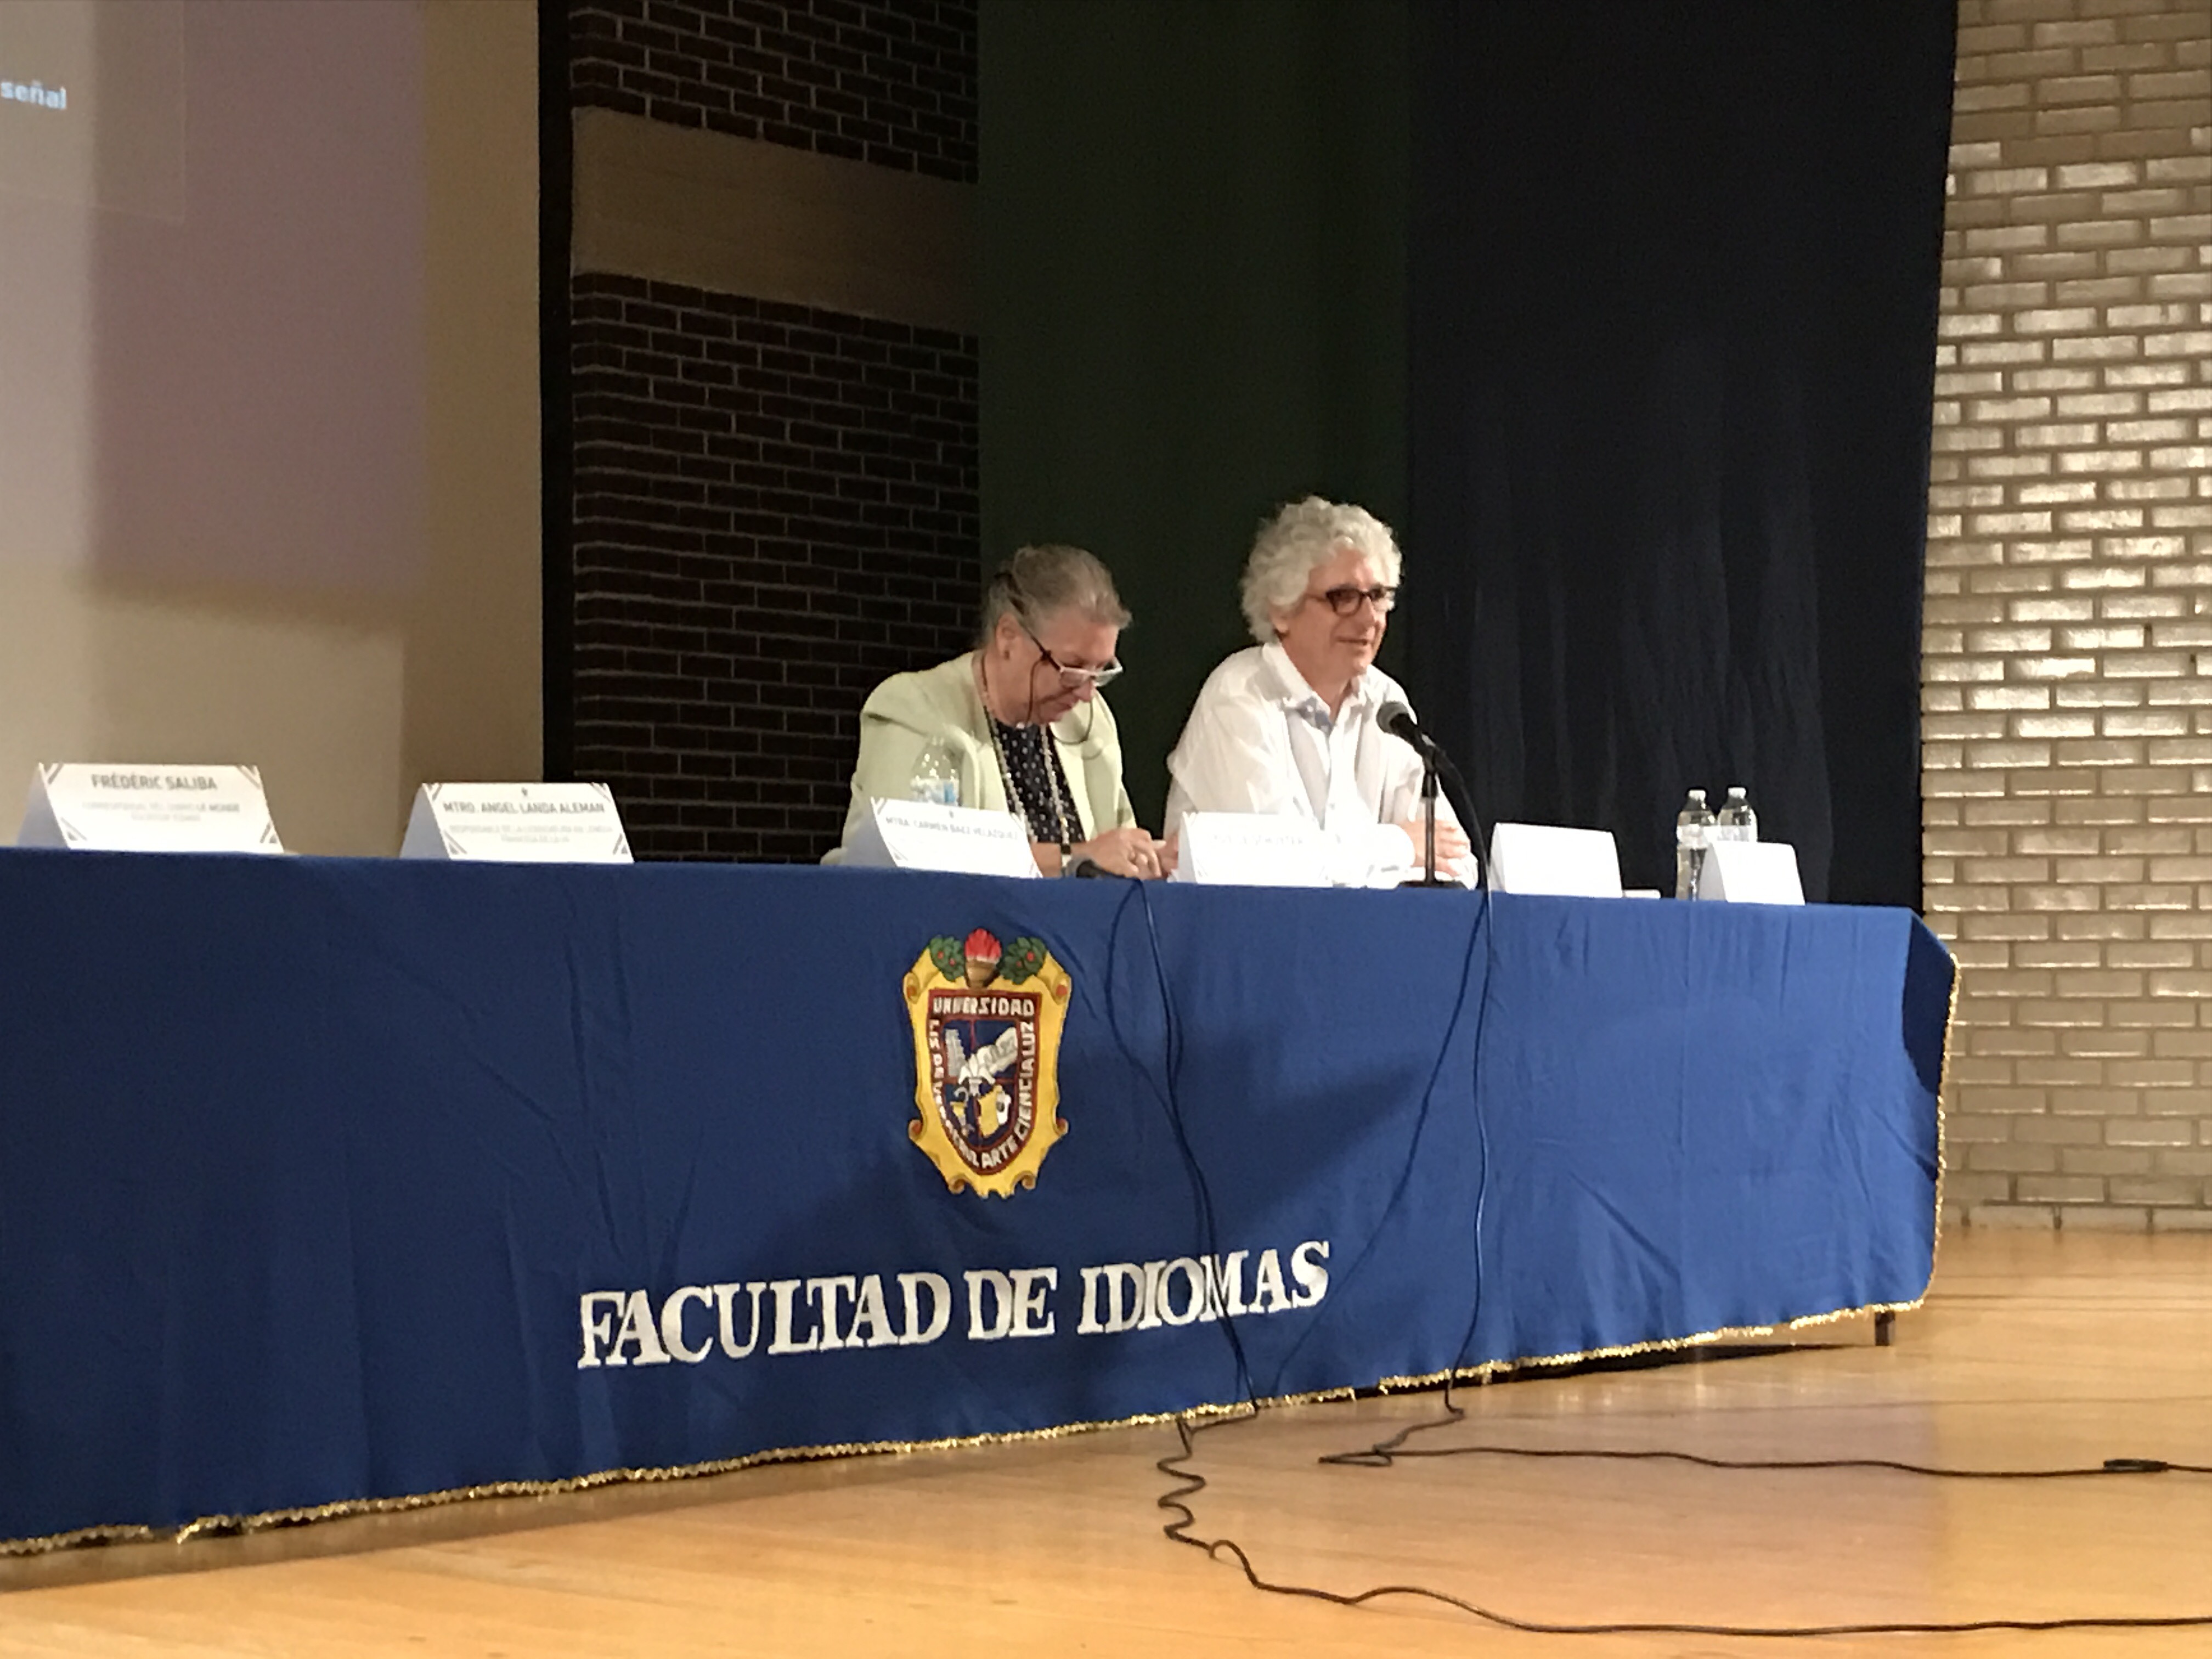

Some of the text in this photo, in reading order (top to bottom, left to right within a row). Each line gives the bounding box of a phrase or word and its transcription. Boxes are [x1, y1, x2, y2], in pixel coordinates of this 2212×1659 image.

[1, 80, 66, 109] señal
[91, 772, 217, 791] FRÉDÉRIC SALIBA
[1019, 1020, 1036, 1057] LUZ
[1014, 1057, 1035, 1141] CIENCIA
[981, 1135, 1018, 1169] ARTE
[577, 1240, 1330, 1370] FACULTAD DE IDIOMAS
